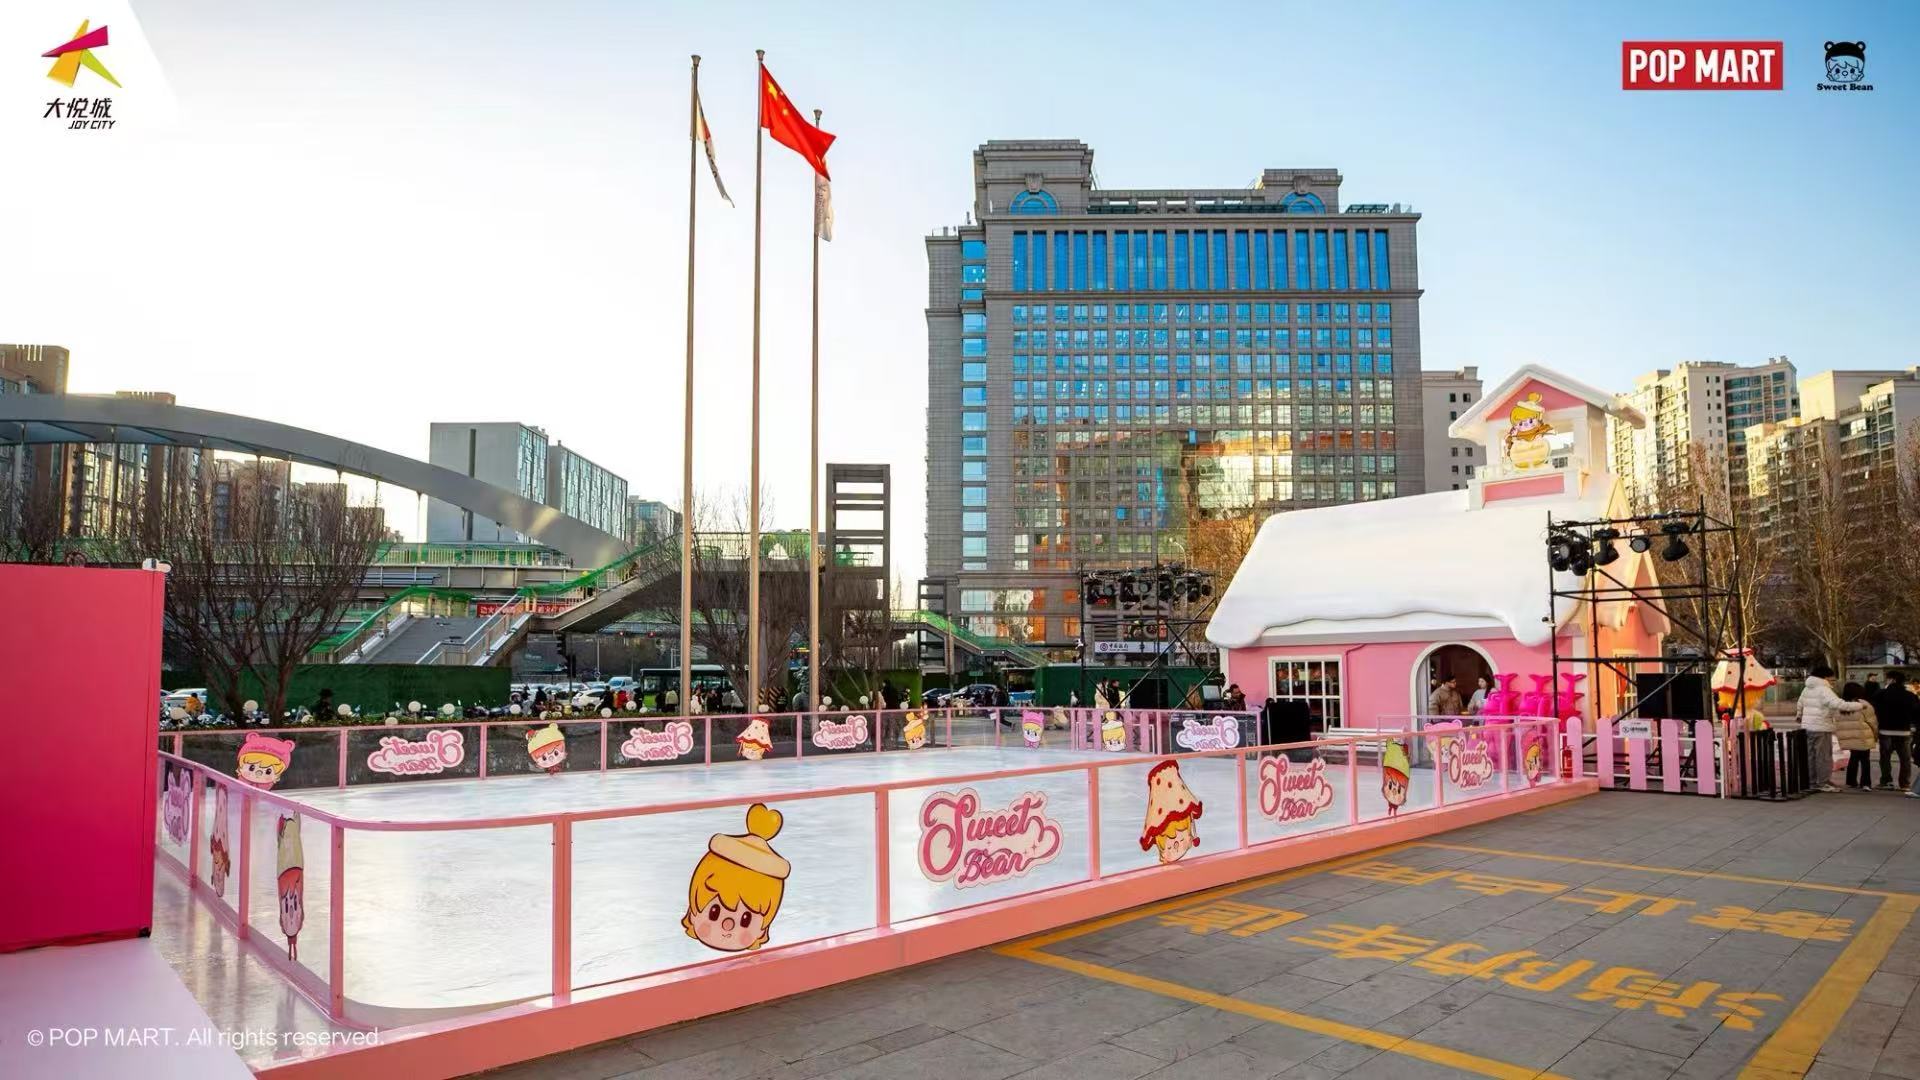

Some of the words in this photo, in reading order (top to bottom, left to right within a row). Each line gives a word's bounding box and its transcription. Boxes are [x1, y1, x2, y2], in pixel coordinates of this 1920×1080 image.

[1260, 760, 1324, 815] Sweet
[1450, 741, 1485, 783] Sweet
[923, 794, 1045, 876] Sweet
[1279, 798, 1318, 820] Bean
[958, 847, 1030, 884] Bean
[1326, 861, 1855, 941] 禁止占用
[1156, 899, 1787, 1032] 消防车道
